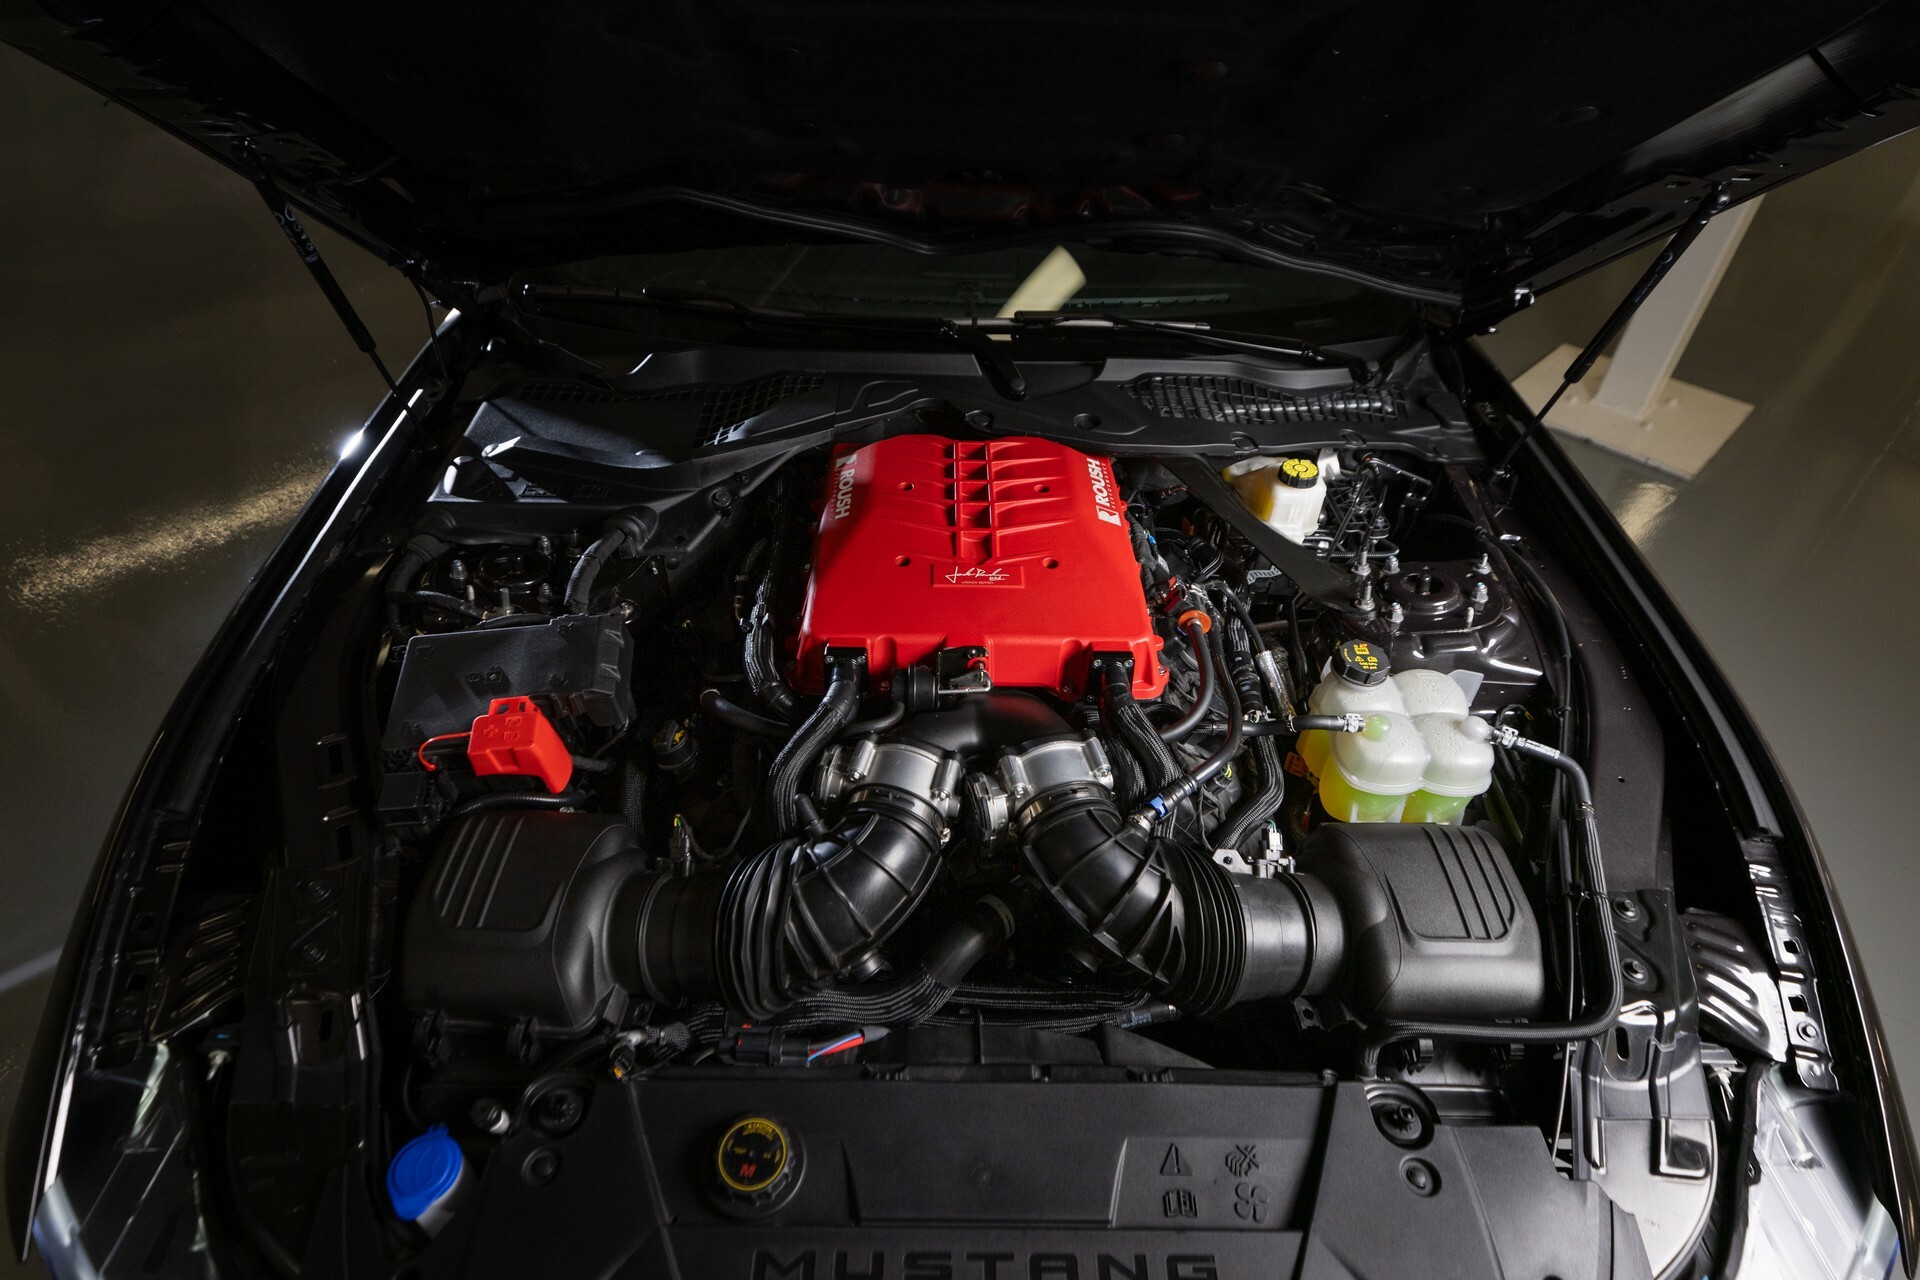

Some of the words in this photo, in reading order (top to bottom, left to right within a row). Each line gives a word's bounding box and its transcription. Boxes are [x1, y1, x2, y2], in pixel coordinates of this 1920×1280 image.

[834, 468, 855, 519] ROUSH
[1086, 457, 1111, 507] ROUSH
[1101, 462, 1116, 509] PERFORMANCE
[752, 1250, 1217, 1280] MUSTANG
